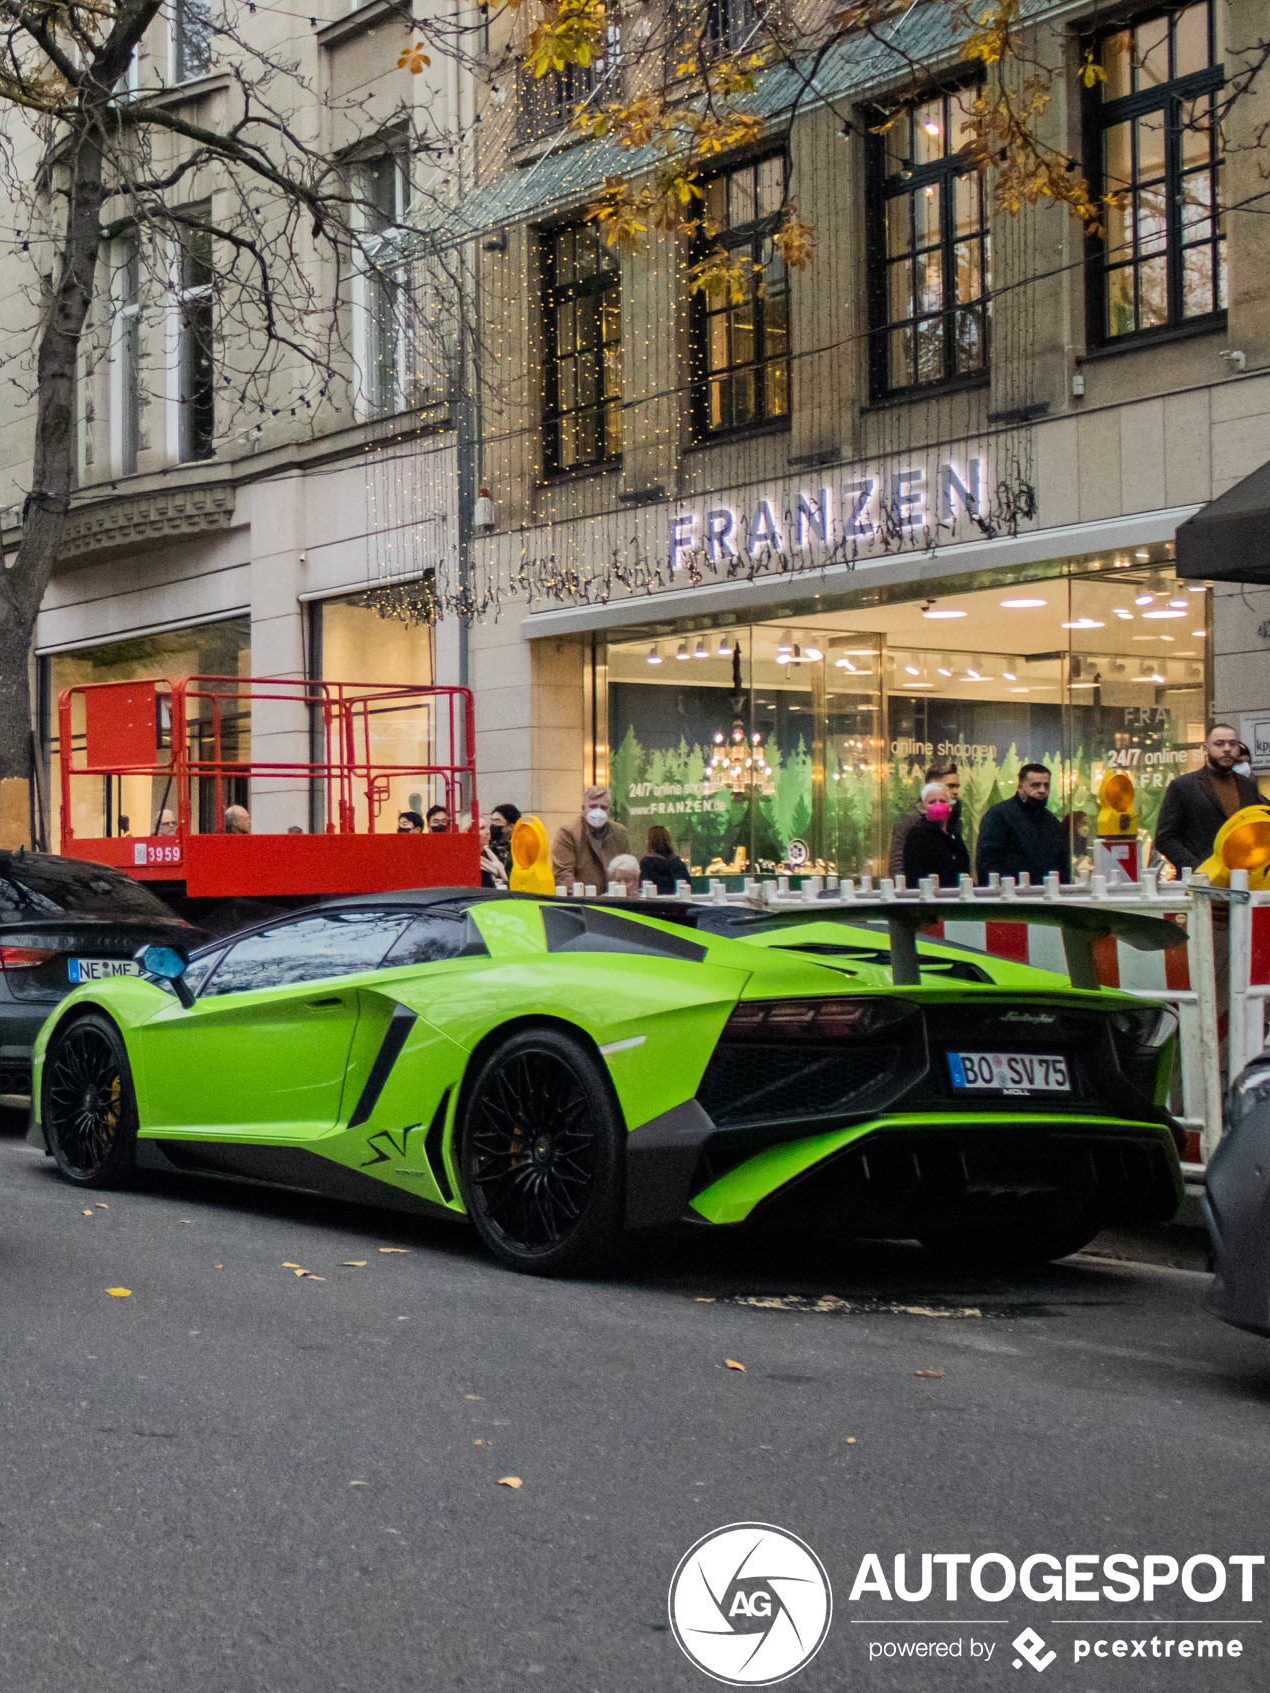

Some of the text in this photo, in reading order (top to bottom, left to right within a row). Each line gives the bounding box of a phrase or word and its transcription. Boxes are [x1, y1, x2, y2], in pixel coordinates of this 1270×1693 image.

[668, 458, 982, 569] FRANZEN
[891, 738, 997, 760] online shoppen
[1107, 748, 1142, 767] 24/7
[1144, 748, 1188, 764] online
[629, 783, 652, 797] 24/7
[654, 783, 682, 796] online
[148, 846, 180, 861] 3959
[80, 962, 101, 979] NE
[961, 1056, 993, 1084] BO
[360, 1122, 423, 1167] SV
